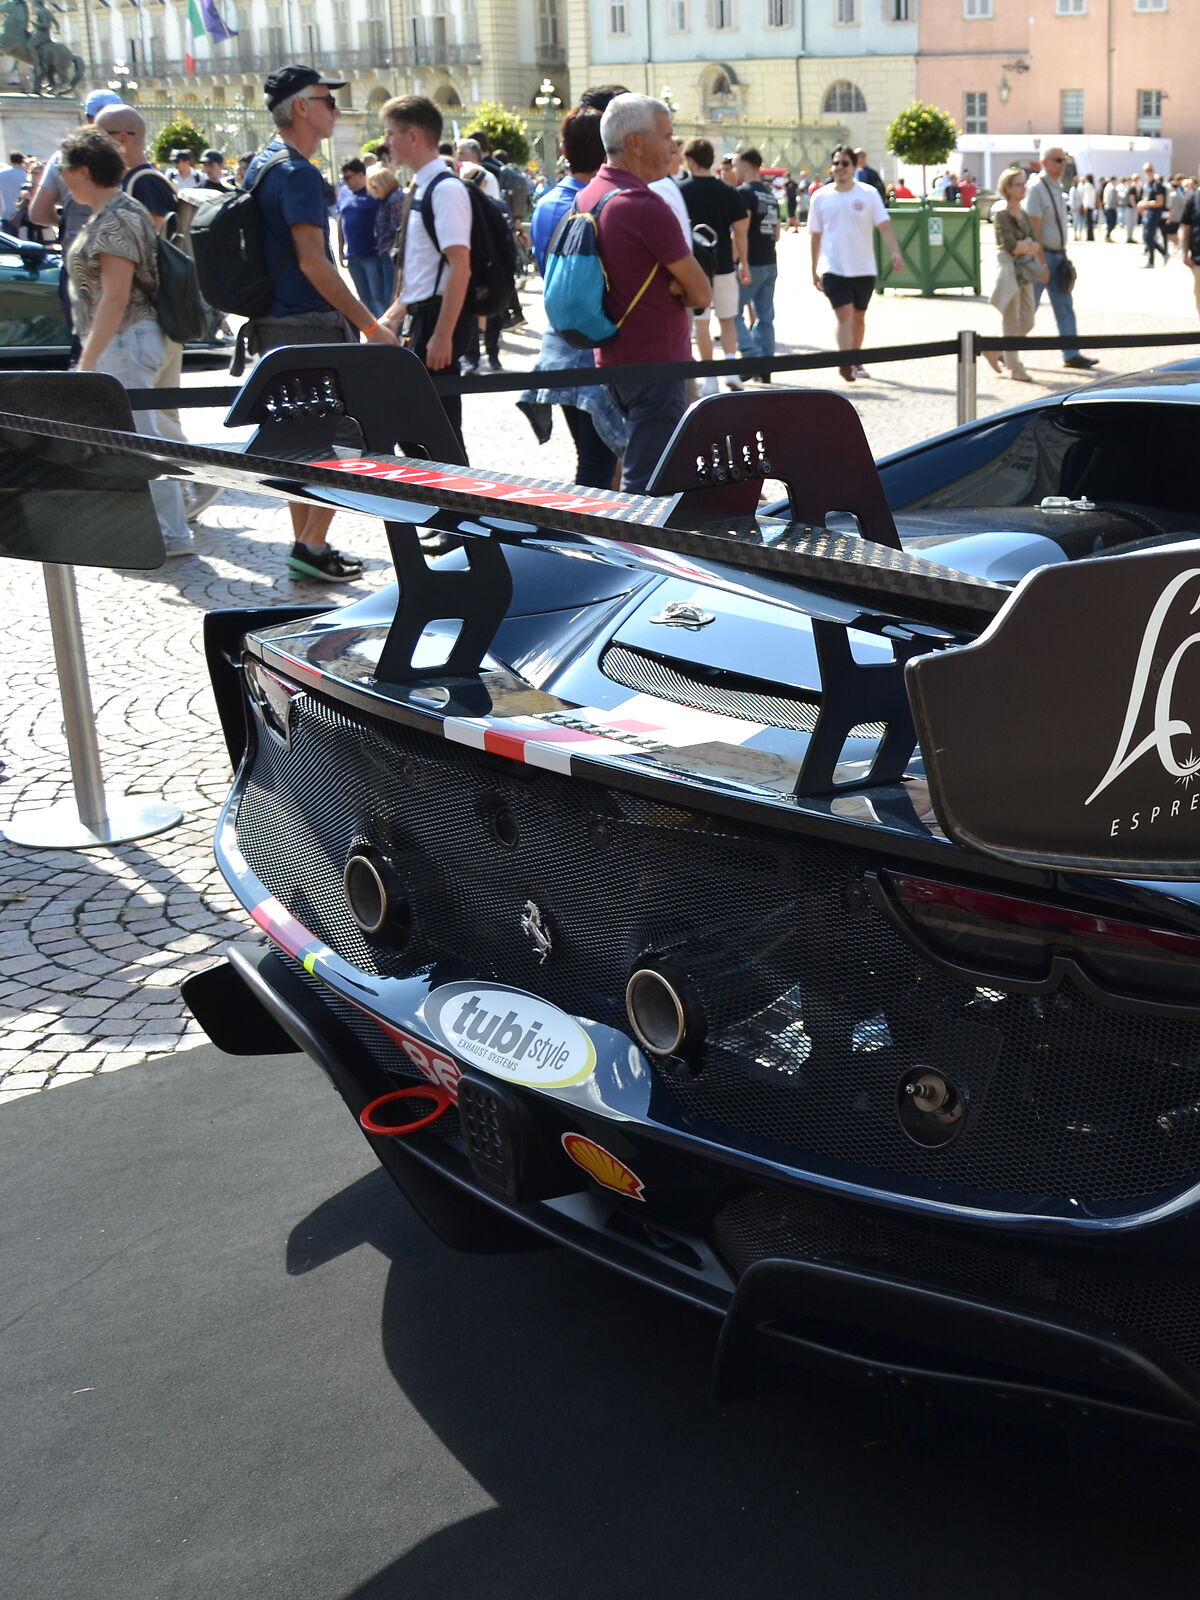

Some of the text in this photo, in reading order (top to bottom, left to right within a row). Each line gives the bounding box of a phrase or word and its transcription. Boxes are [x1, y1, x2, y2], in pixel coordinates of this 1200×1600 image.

[338, 461, 602, 514] RACING
[452, 995, 570, 1071] tubi style
[457, 1038, 519, 1072] EXHAUST SYSTEMS
